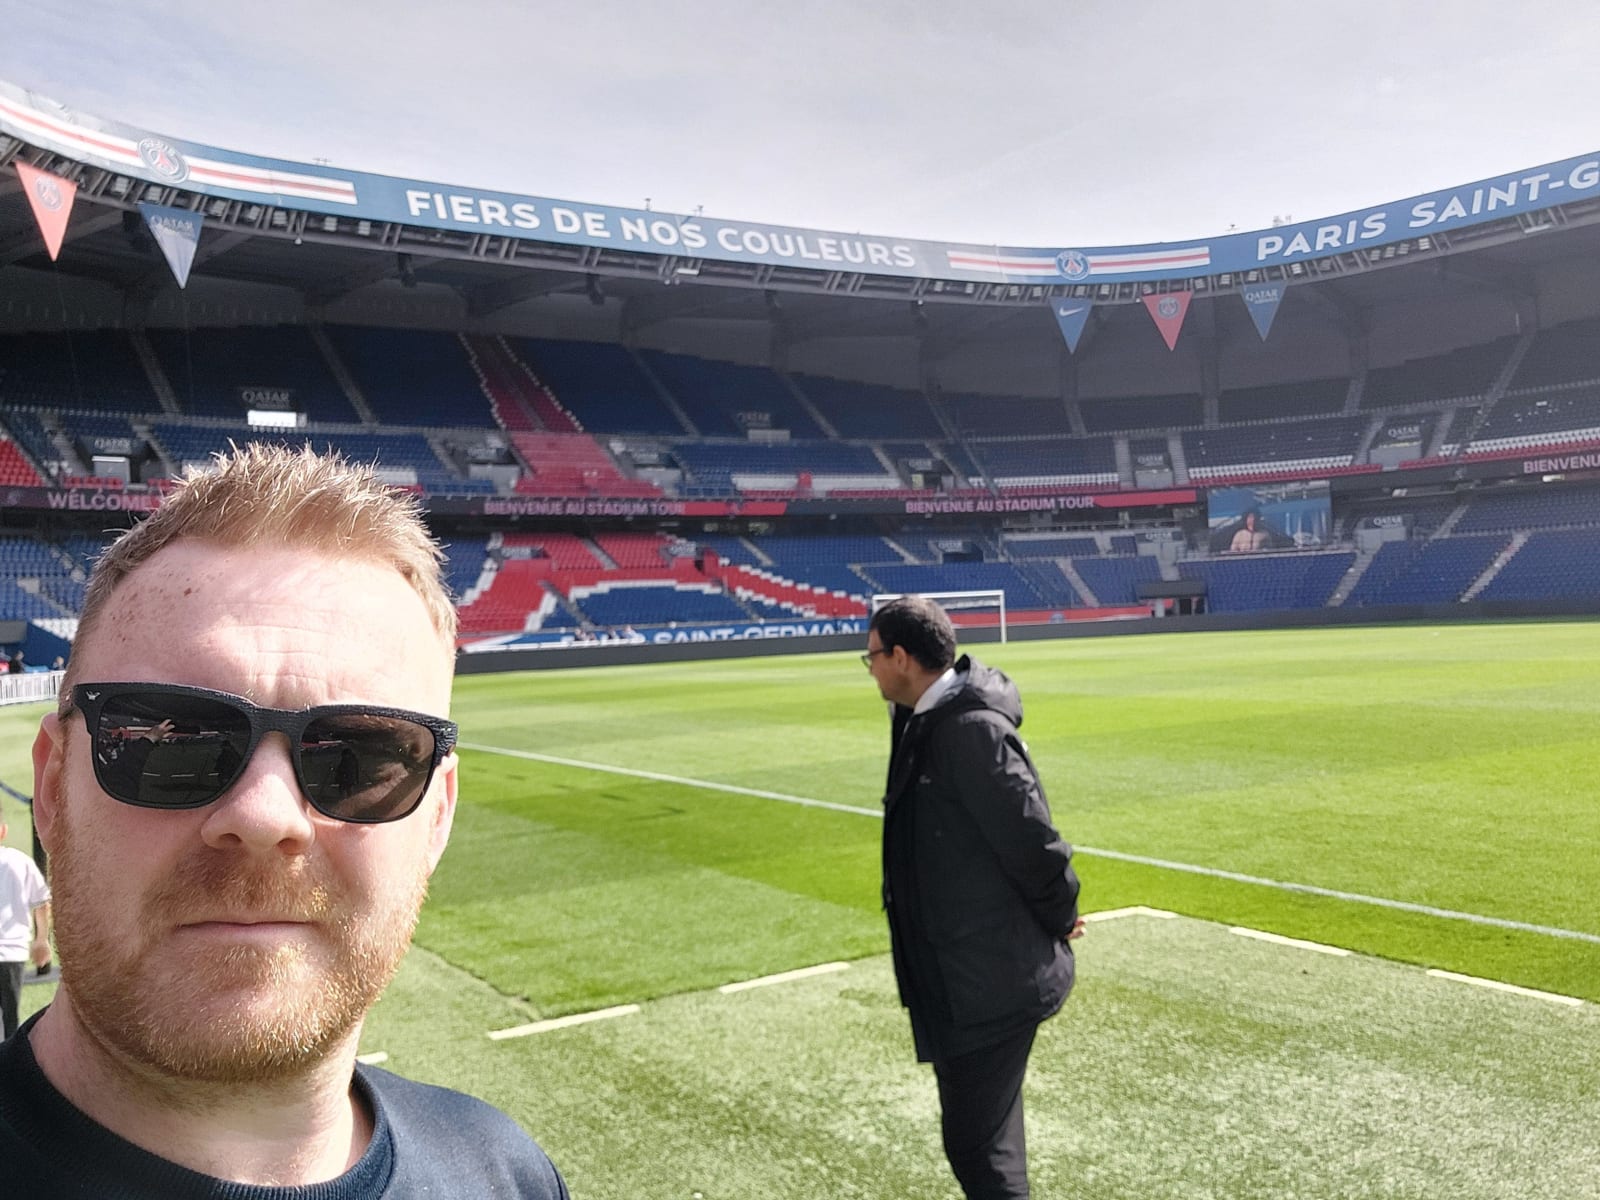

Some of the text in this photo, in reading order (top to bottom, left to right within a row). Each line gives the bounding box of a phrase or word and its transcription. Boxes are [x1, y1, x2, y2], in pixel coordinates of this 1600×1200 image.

[1257, 161, 1600, 261] PARIS SAINT-G
[406, 189, 917, 268] FIERS DE NOS COULEURS
[1246, 288, 1279, 302] QATAR
[242, 389, 289, 403] QATAR
[1523, 454, 1600, 474] BIENVENU
[47, 491, 152, 512] WELCOME
[484, 501, 686, 515] BIENVENUE AU STADIUM TOUR
[905, 496, 1094, 514] BIENVENUE AU STADIUM TOUR
